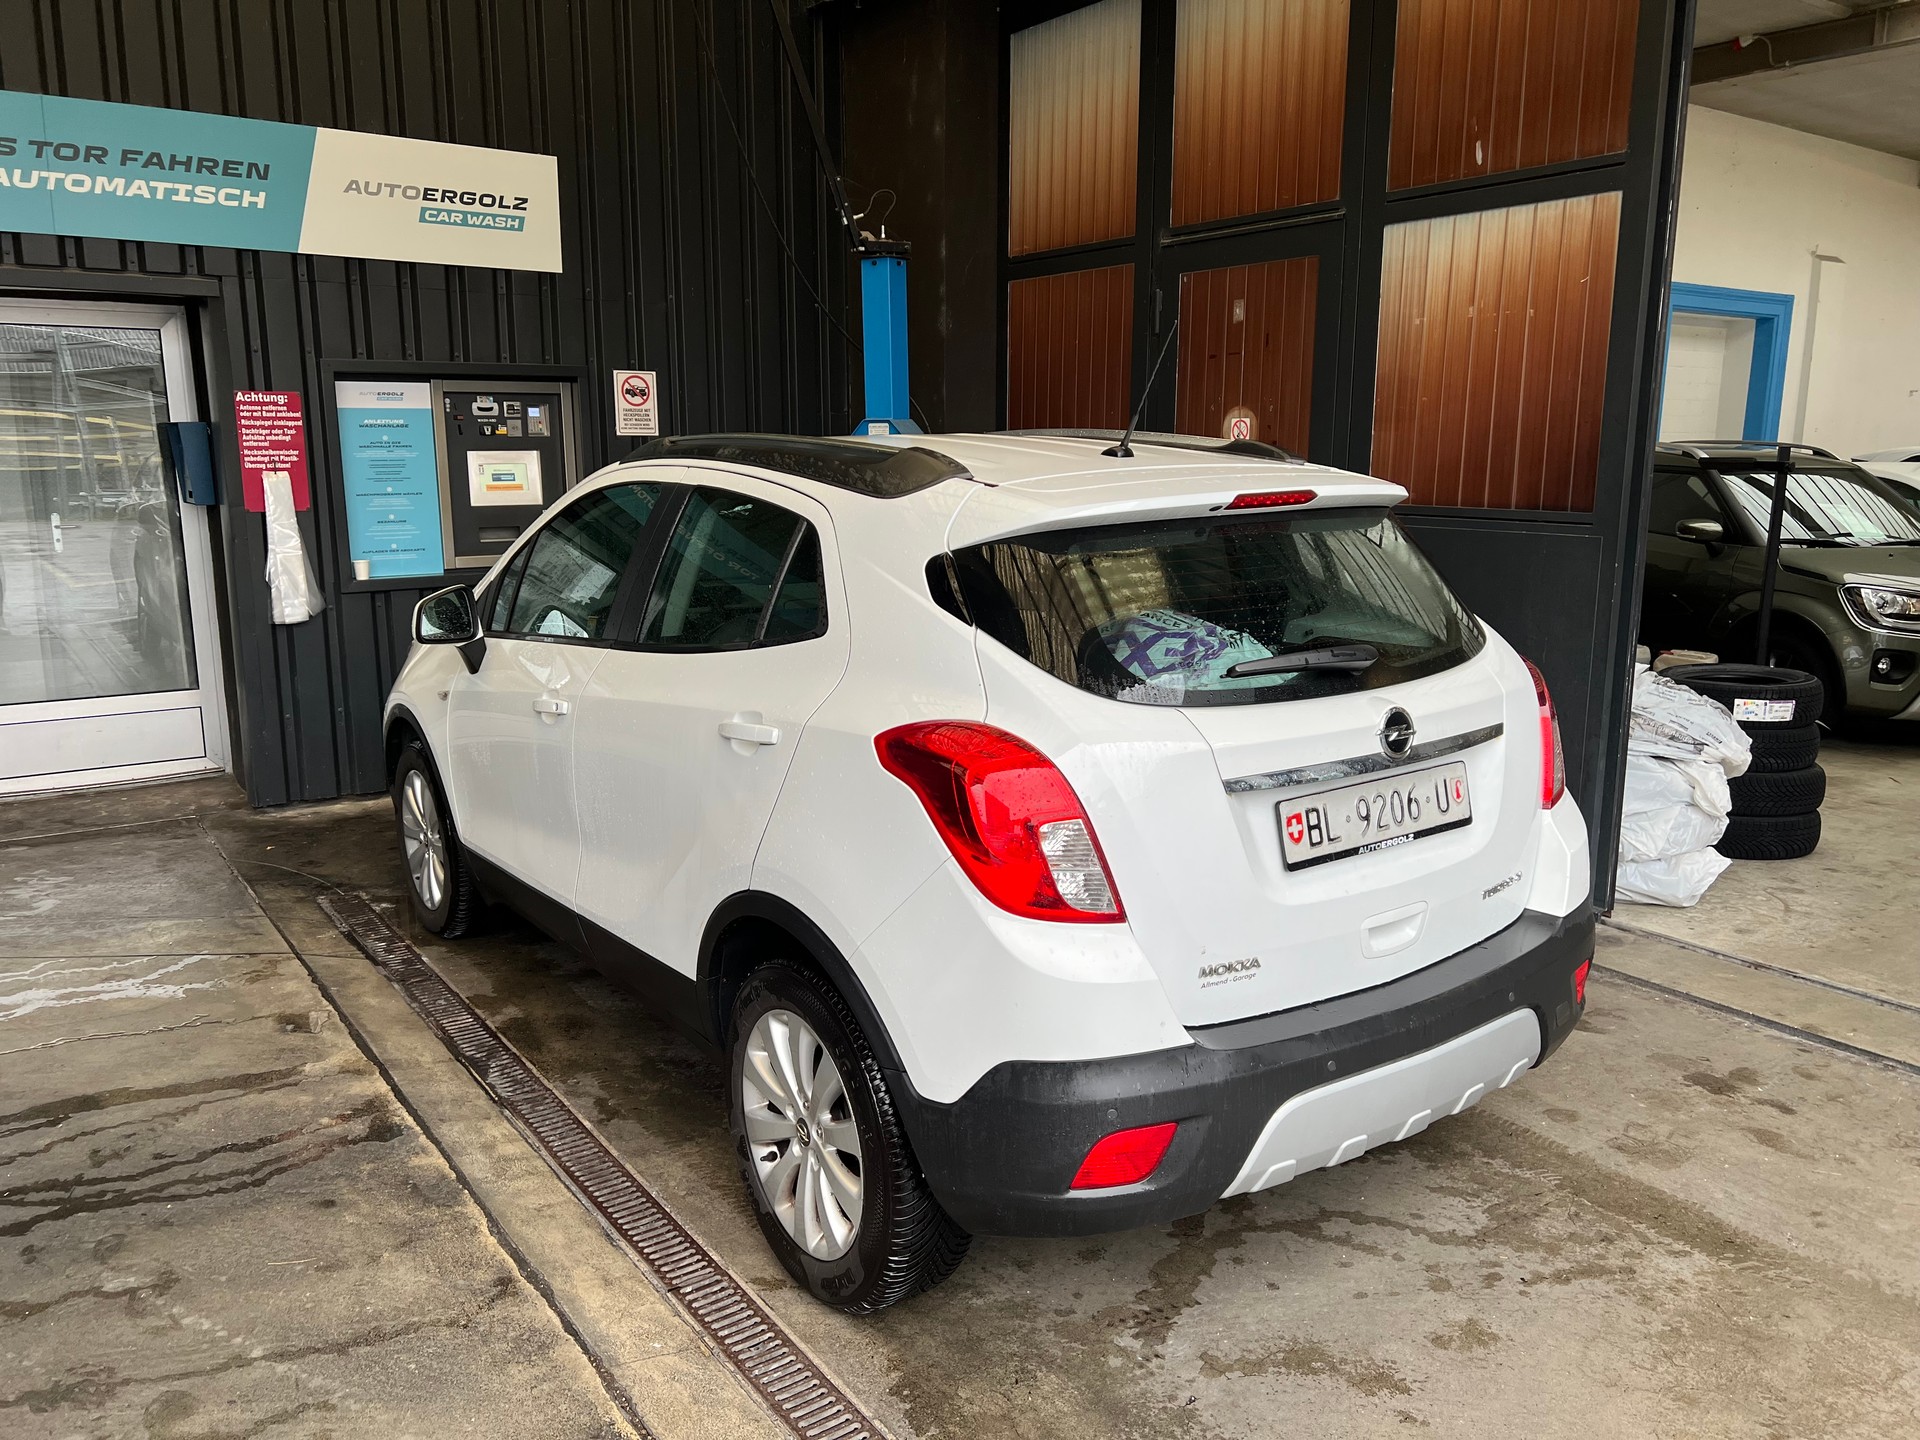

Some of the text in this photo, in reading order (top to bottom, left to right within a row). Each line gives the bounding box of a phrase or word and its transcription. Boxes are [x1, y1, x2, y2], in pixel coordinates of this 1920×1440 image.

[28, 140, 108, 164] TOR
[120, 149, 270, 181] FAHREN
[343, 179, 529, 212] AUTOERGOLZ
[424, 210, 520, 229] CAR WASH
[236, 392, 288, 404] Achtung:
[1305, 776, 1450, 848] BL 9206 U
[1358, 833, 1415, 855] AUTOERGOLZ
[1198, 956, 1262, 979] MOKKA
